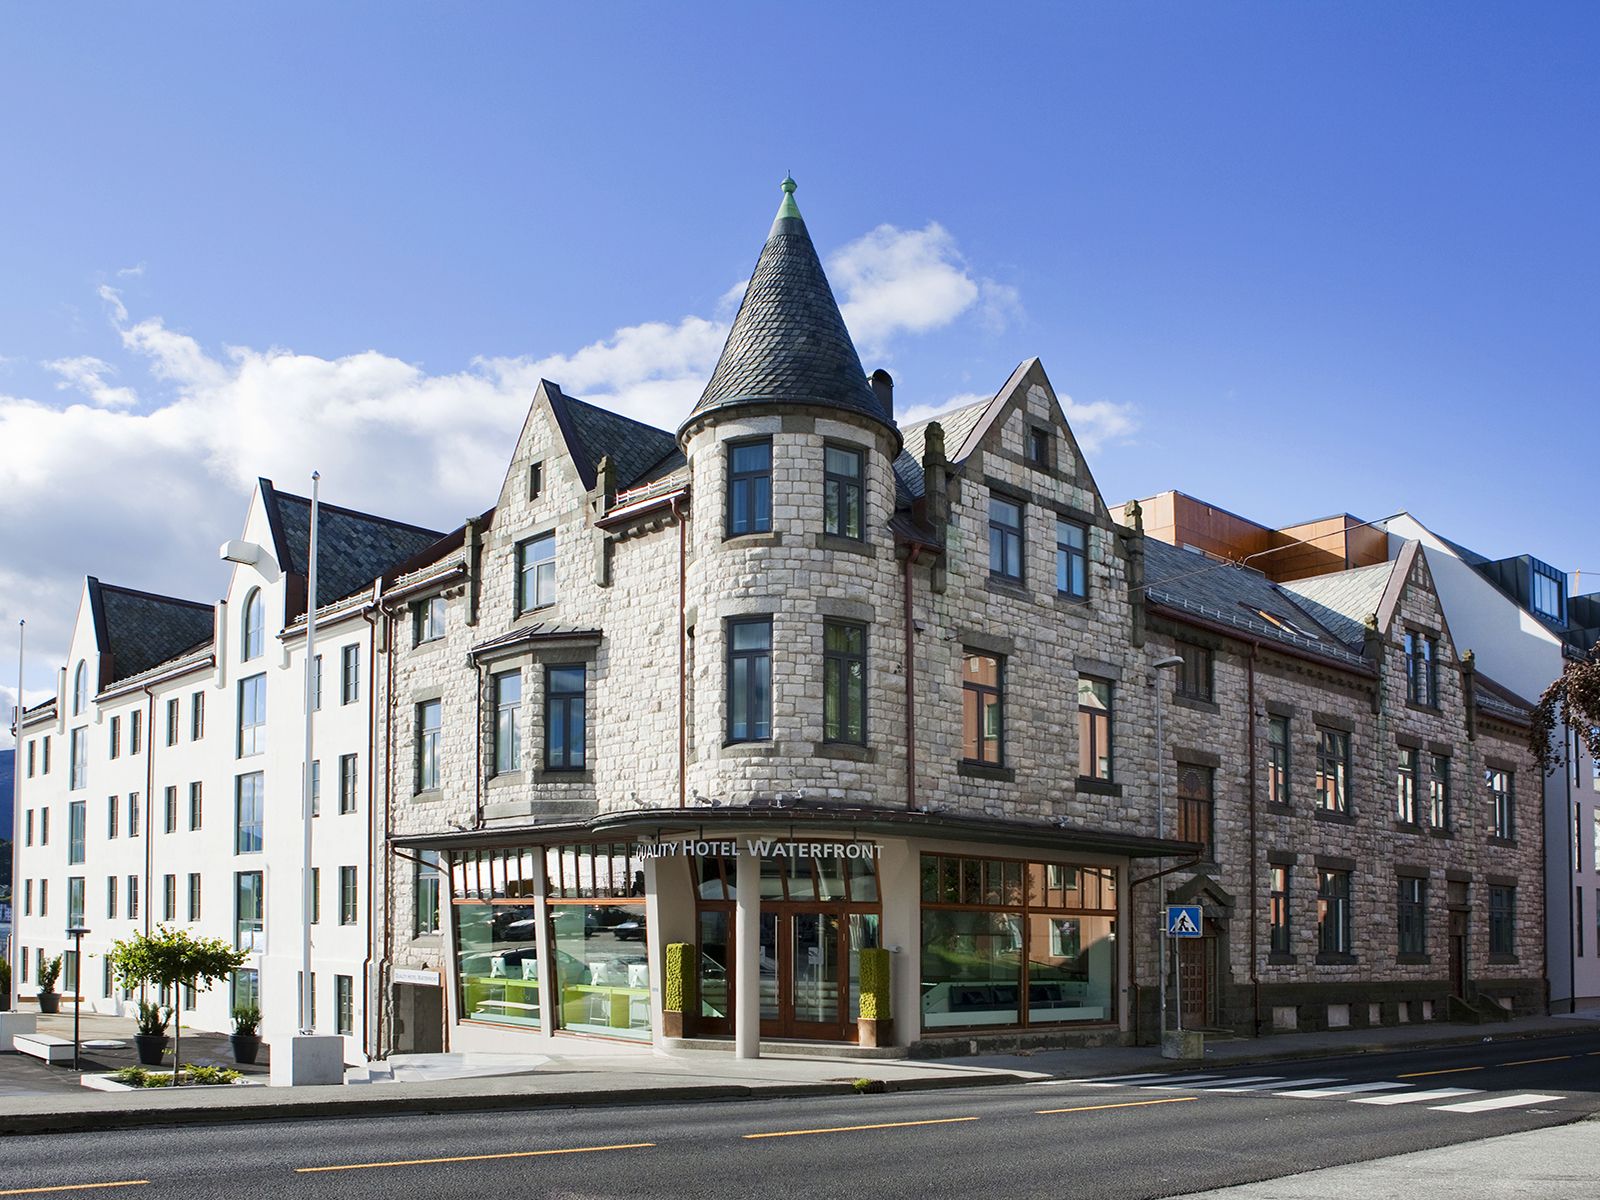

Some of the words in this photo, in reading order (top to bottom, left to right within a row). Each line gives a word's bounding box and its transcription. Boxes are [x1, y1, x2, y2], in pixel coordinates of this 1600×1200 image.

[635, 842, 678, 861] QUALITY
[682, 840, 741, 857] HOTEL
[746, 839, 885, 859] WATERFRONT
